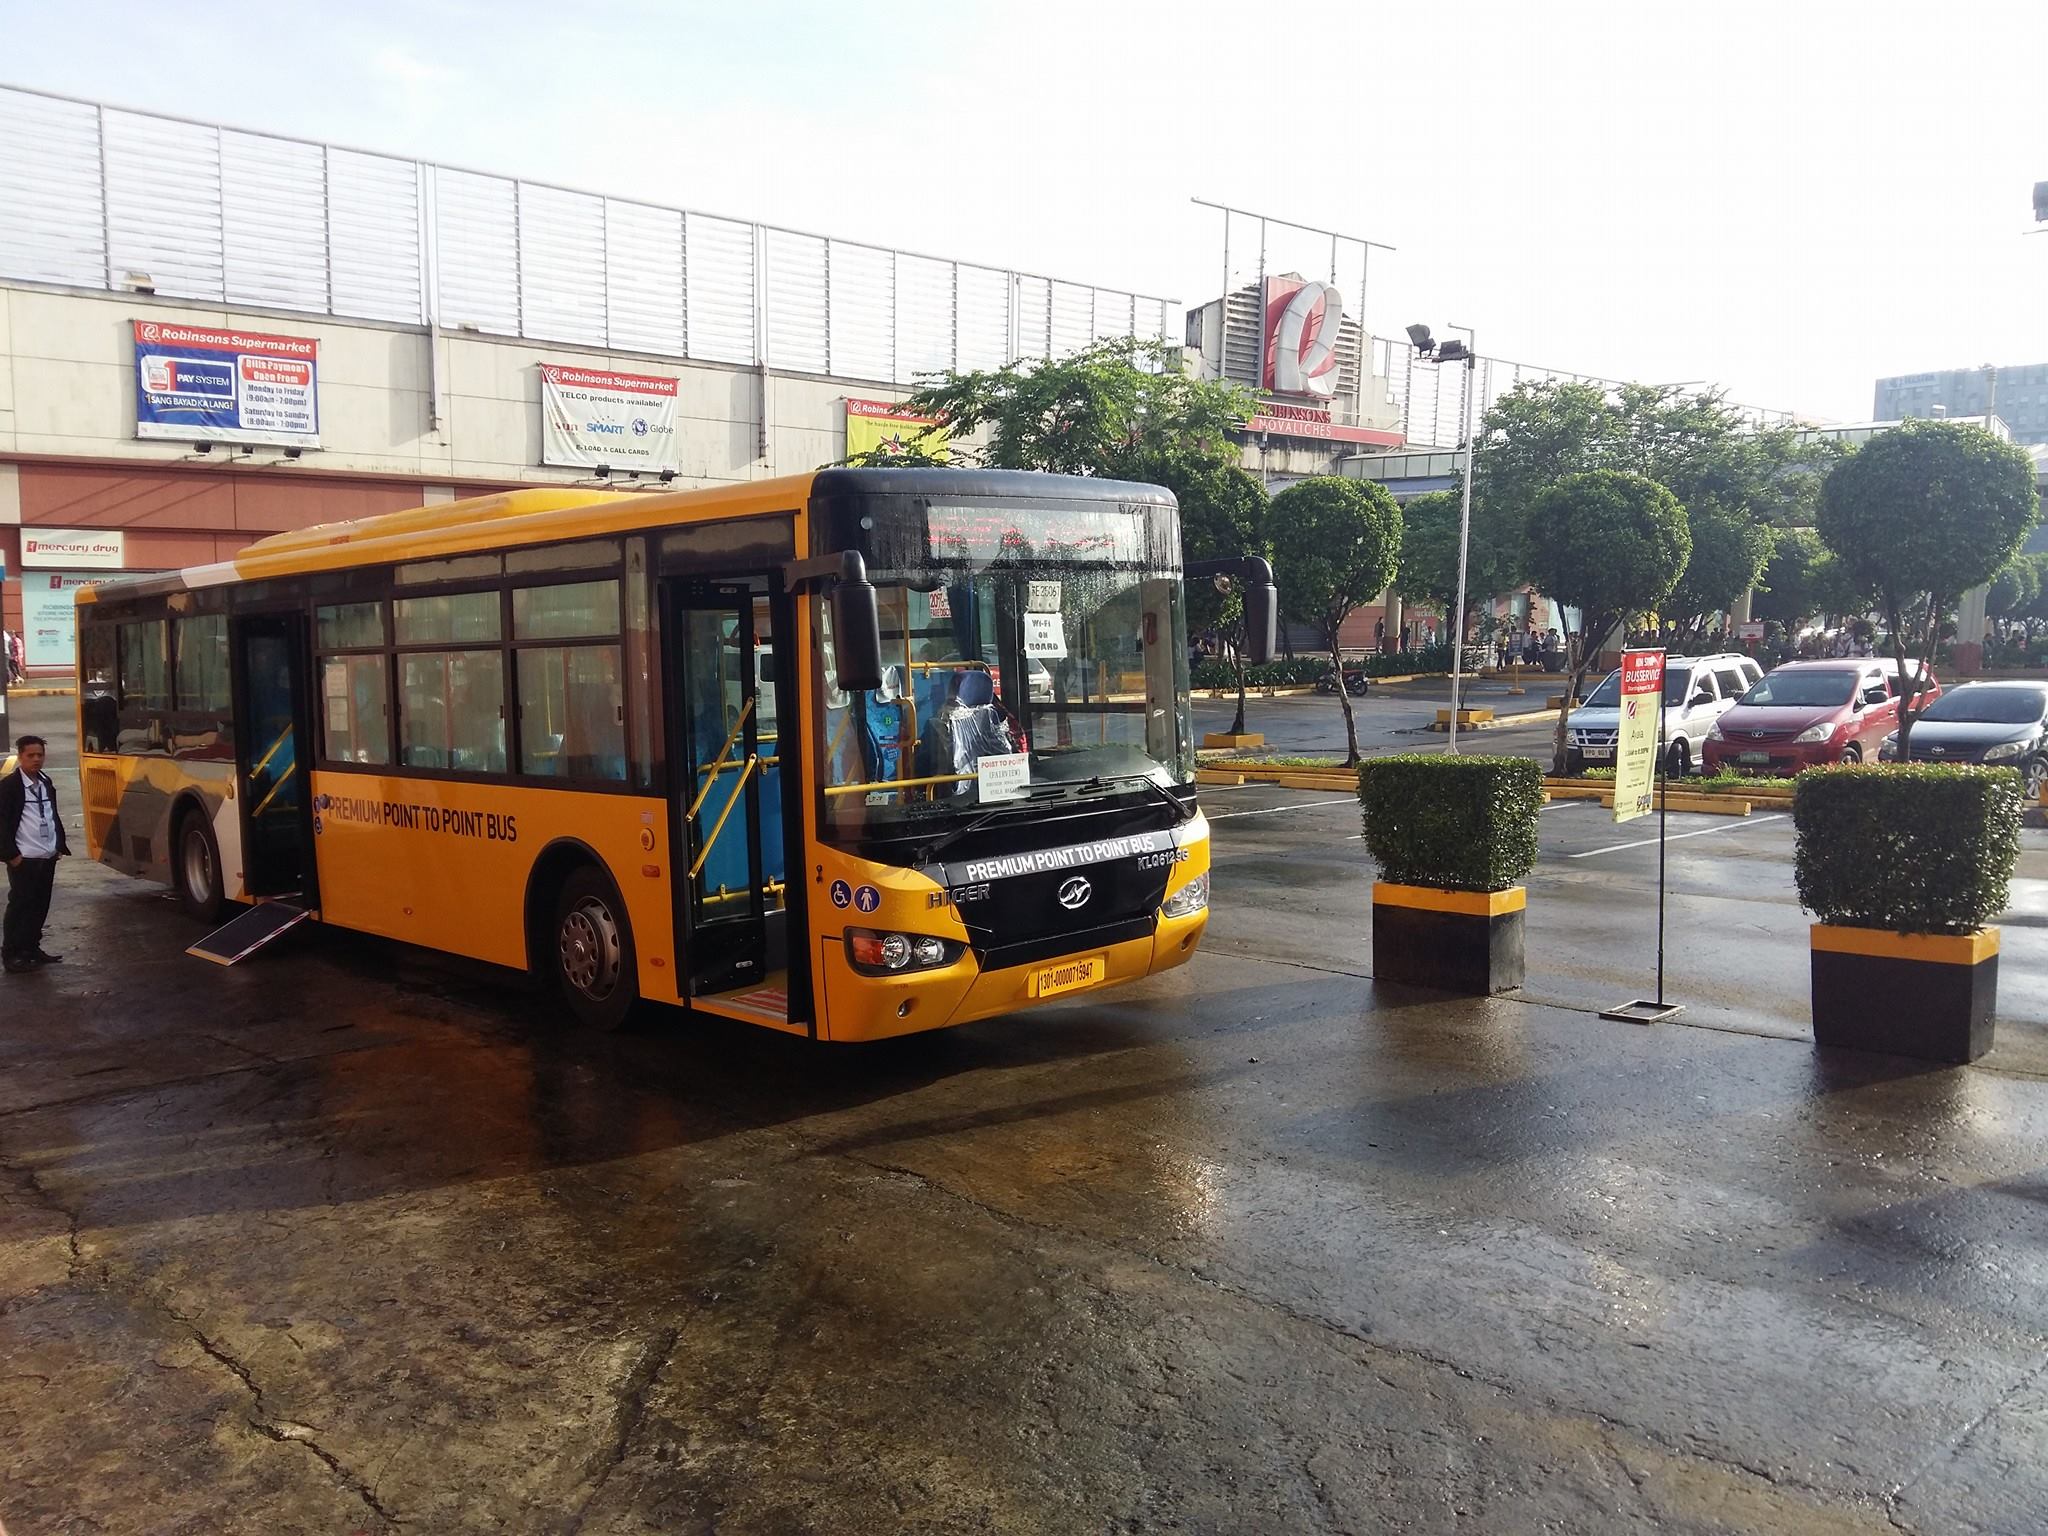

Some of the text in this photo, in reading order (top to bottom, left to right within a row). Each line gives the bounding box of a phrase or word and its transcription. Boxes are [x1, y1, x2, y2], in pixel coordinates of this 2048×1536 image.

[162, 329, 311, 353] Robinsons Supermarket
[246, 358, 306, 373] Bills Payment
[177, 374, 195, 384] PAY
[195, 375, 229, 386] SYSTEM
[253, 371, 298, 384] Open From
[562, 371, 674, 392] Robinsons Supermarket
[248, 384, 274, 395] Monday
[284, 388, 305, 396] Friday
[173, 397, 197, 407] BAYAD
[198, 399, 209, 408] KA
[209, 400, 233, 410] LANG!
[560, 391, 663, 408] TELCO products available!
[244, 407, 274, 417] Saturday
[284, 411, 309, 420] Sunday
[862, 404, 900, 416] Robins
[587, 423, 624, 435] SMART
[650, 424, 674, 434] Globe
[1259, 419, 1332, 437] NOVALICHES
[38, 543, 119, 553] mercury drug
[329, 797, 517, 842] PREMIUM POINT TO POINT BUS
[966, 836, 1156, 882] PREMIUM POINT TO POINT BUS
[928, 883, 990, 909] HIGER
